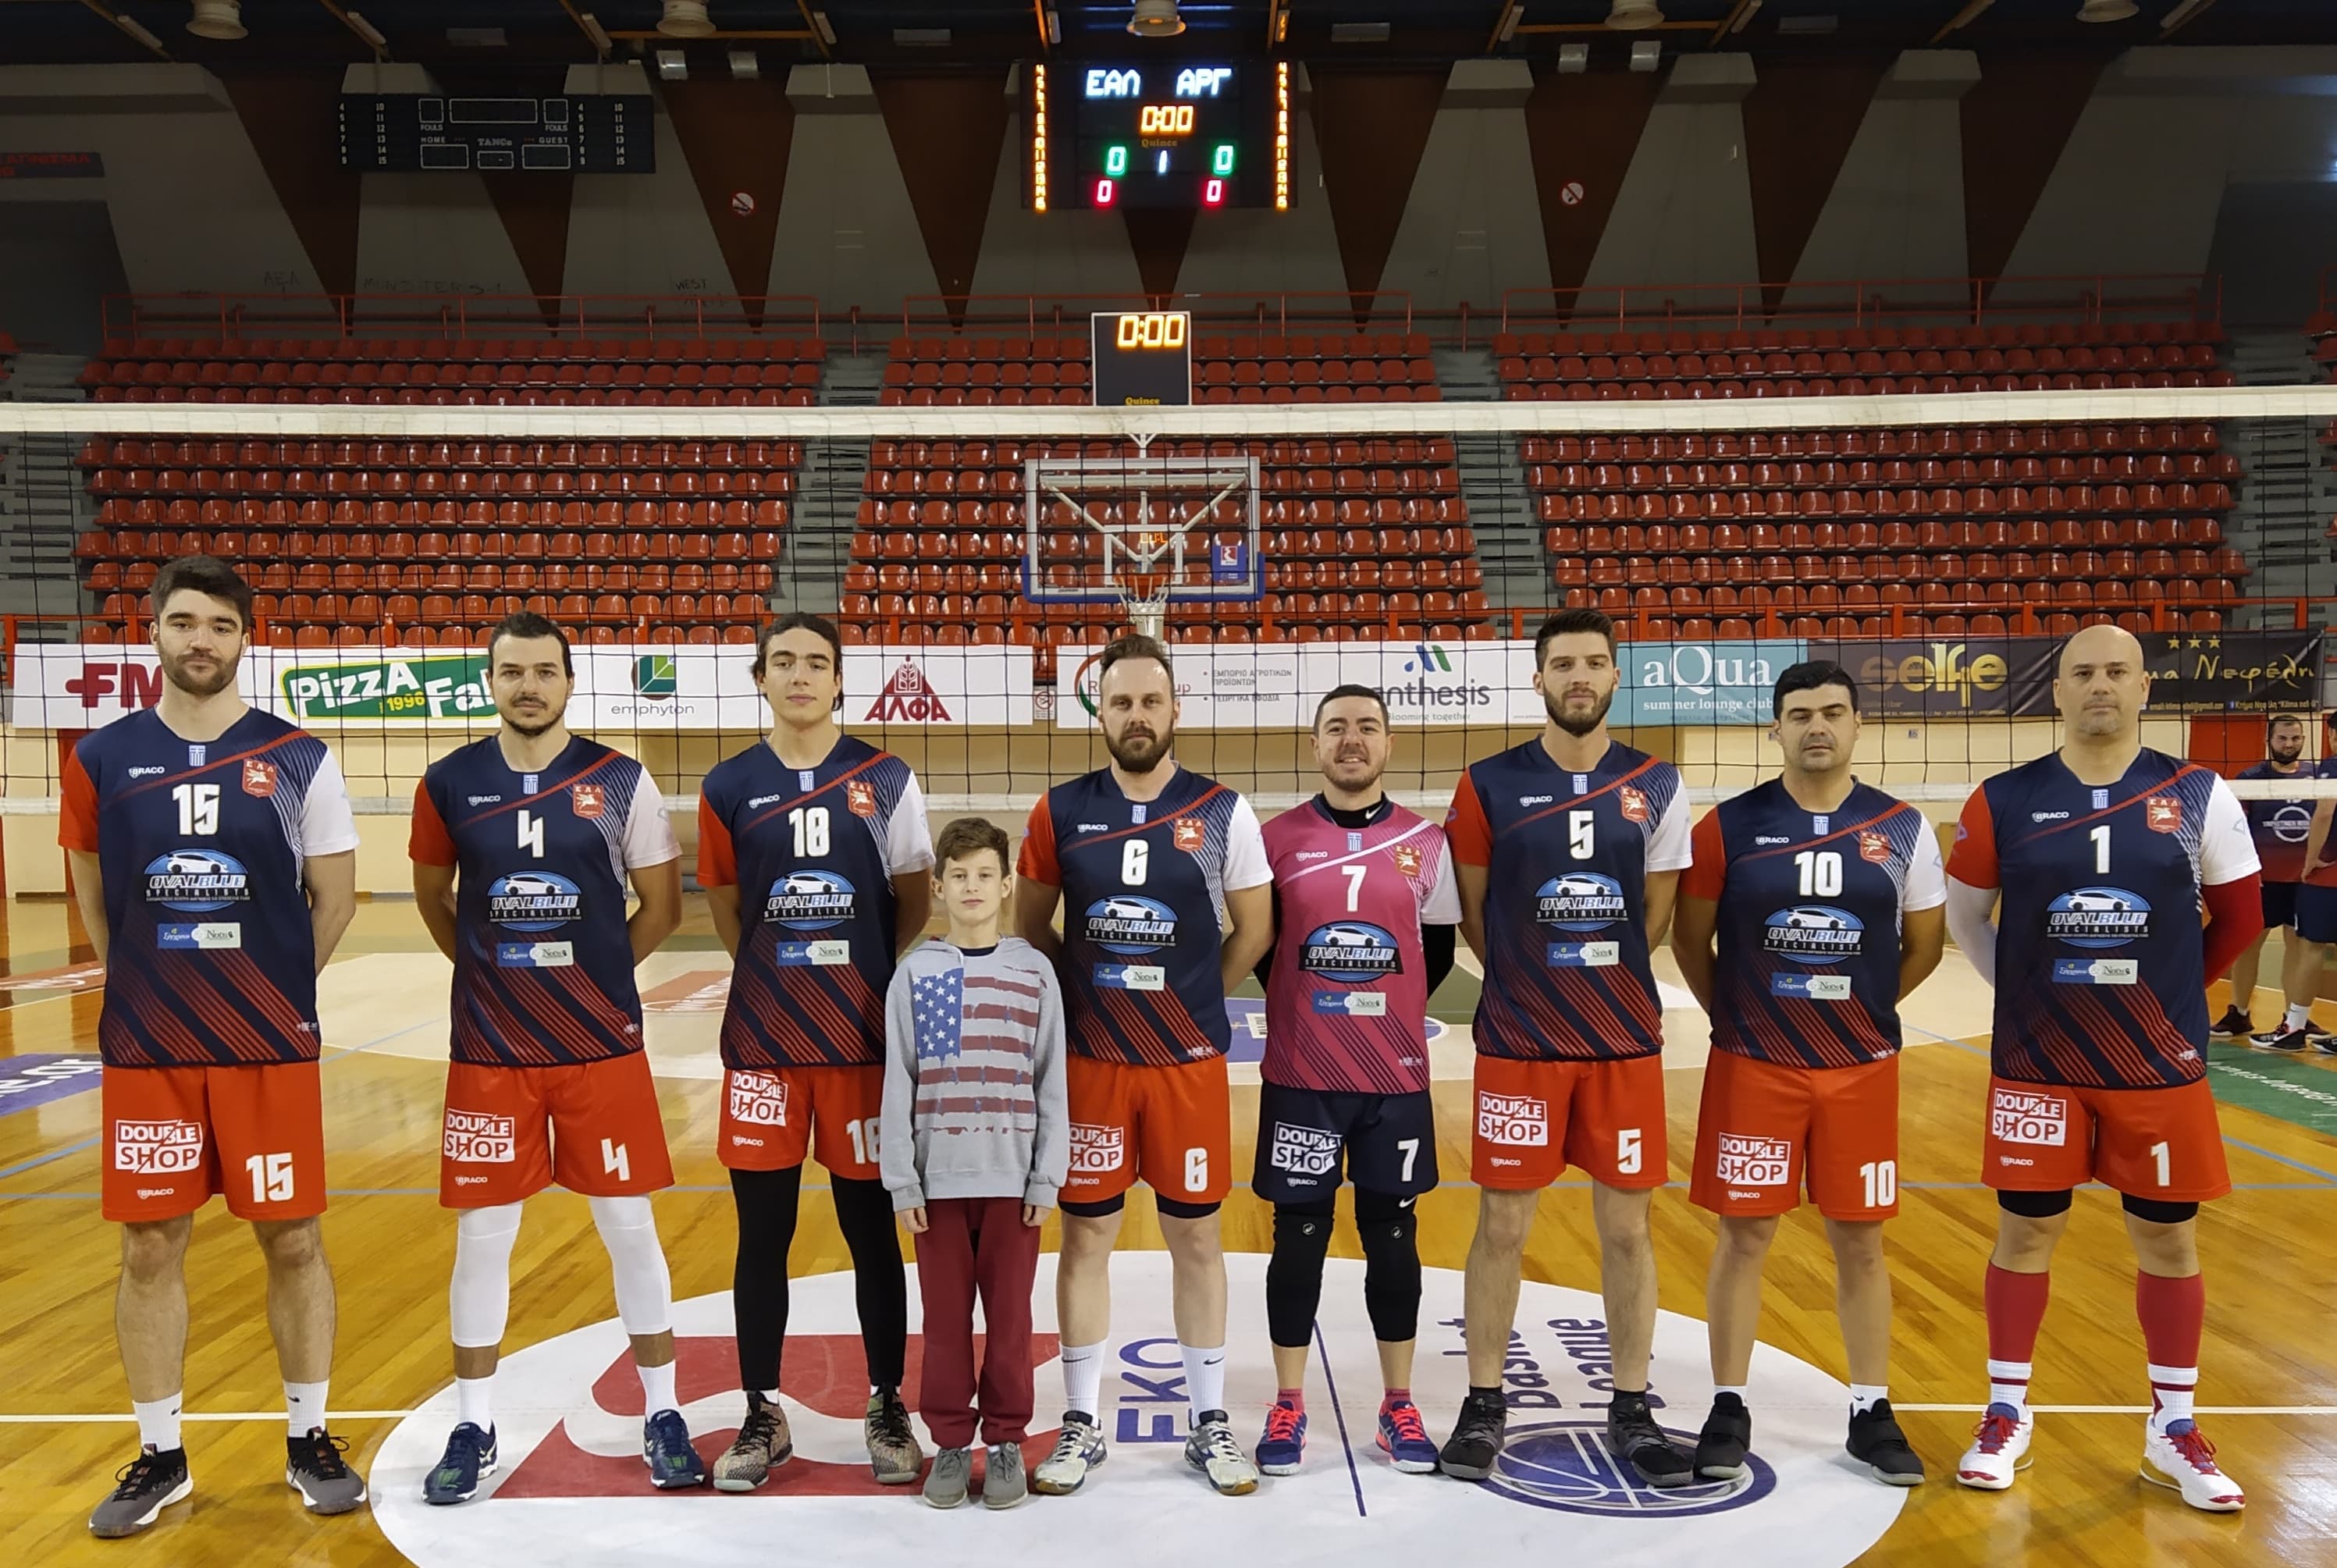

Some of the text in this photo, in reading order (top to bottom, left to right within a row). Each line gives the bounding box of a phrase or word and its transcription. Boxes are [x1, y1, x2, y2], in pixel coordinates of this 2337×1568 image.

[1141, 105, 1193, 133] 0:00
[1106, 145, 1127, 174] 0
[1214, 144, 1233, 173] 0
[1096, 180, 1113, 203] 0
[1206, 180, 1223, 203] 0
[1117, 315, 1185, 348] 0:00
[1643, 645, 1773, 695] aQua
[386, 691, 425, 711] 1996
[610, 704, 695, 717] emphyton
[1643, 698, 1773, 713] summer lounge club
[1432, 711, 1471, 722] together
[172, 784, 221, 836] 15
[518, 809, 544, 858] 4
[788, 806, 830, 858] 18
[1569, 810, 1595, 860] 5
[1121, 838, 1149, 886] 6
[2090, 824, 2111, 874] 1
[149, 875, 246, 888] OVALBLUE
[1795, 851, 1843, 898] 10
[1342, 865, 1367, 912] 7
[491, 895, 578, 910] OVALBLUE
[767, 894, 853, 910] OVALBLUE
[1539, 897, 1625, 910] OVALBLUE
[1088, 918, 1175, 935] OVALBLUE
[2051, 912, 2148, 925] OVALBLUE
[1767, 927, 1862, 944] OVALBLUE
[1308, 946, 1396, 961] OVALBLUE
[734, 1072, 783, 1099] DOUBLE
[1482, 1096, 1542, 1119] DOUBLE
[1996, 1093, 2060, 1118] DOUBLE
[120, 1125, 197, 1144] DOUBLE
[447, 1114, 509, 1136] DOUBLE
[1069, 1127, 1120, 1147] OUBLE
[1279, 1126, 1336, 1150] DOUBLE
[1482, 1115, 1542, 1141] SHOP
[1994, 1113, 2058, 1140] SHOP
[445, 1133, 507, 1159] SHOP
[846, 1116, 880, 1164] 18
[1618, 1128, 1642, 1174] 5
[1721, 1139, 1785, 1159] DOUBLE
[121, 1146, 196, 1169] SHOP
[600, 1138, 631, 1182] 4
[1069, 1147, 1119, 1168] HOP
[1184, 1147, 1208, 1193] 6
[1397, 1138, 1420, 1182] 7
[1720, 1157, 1784, 1181] SHOP
[2150, 1141, 2170, 1186] 1
[246, 1152, 293, 1203] 15
[1859, 1160, 1896, 1207] 10
